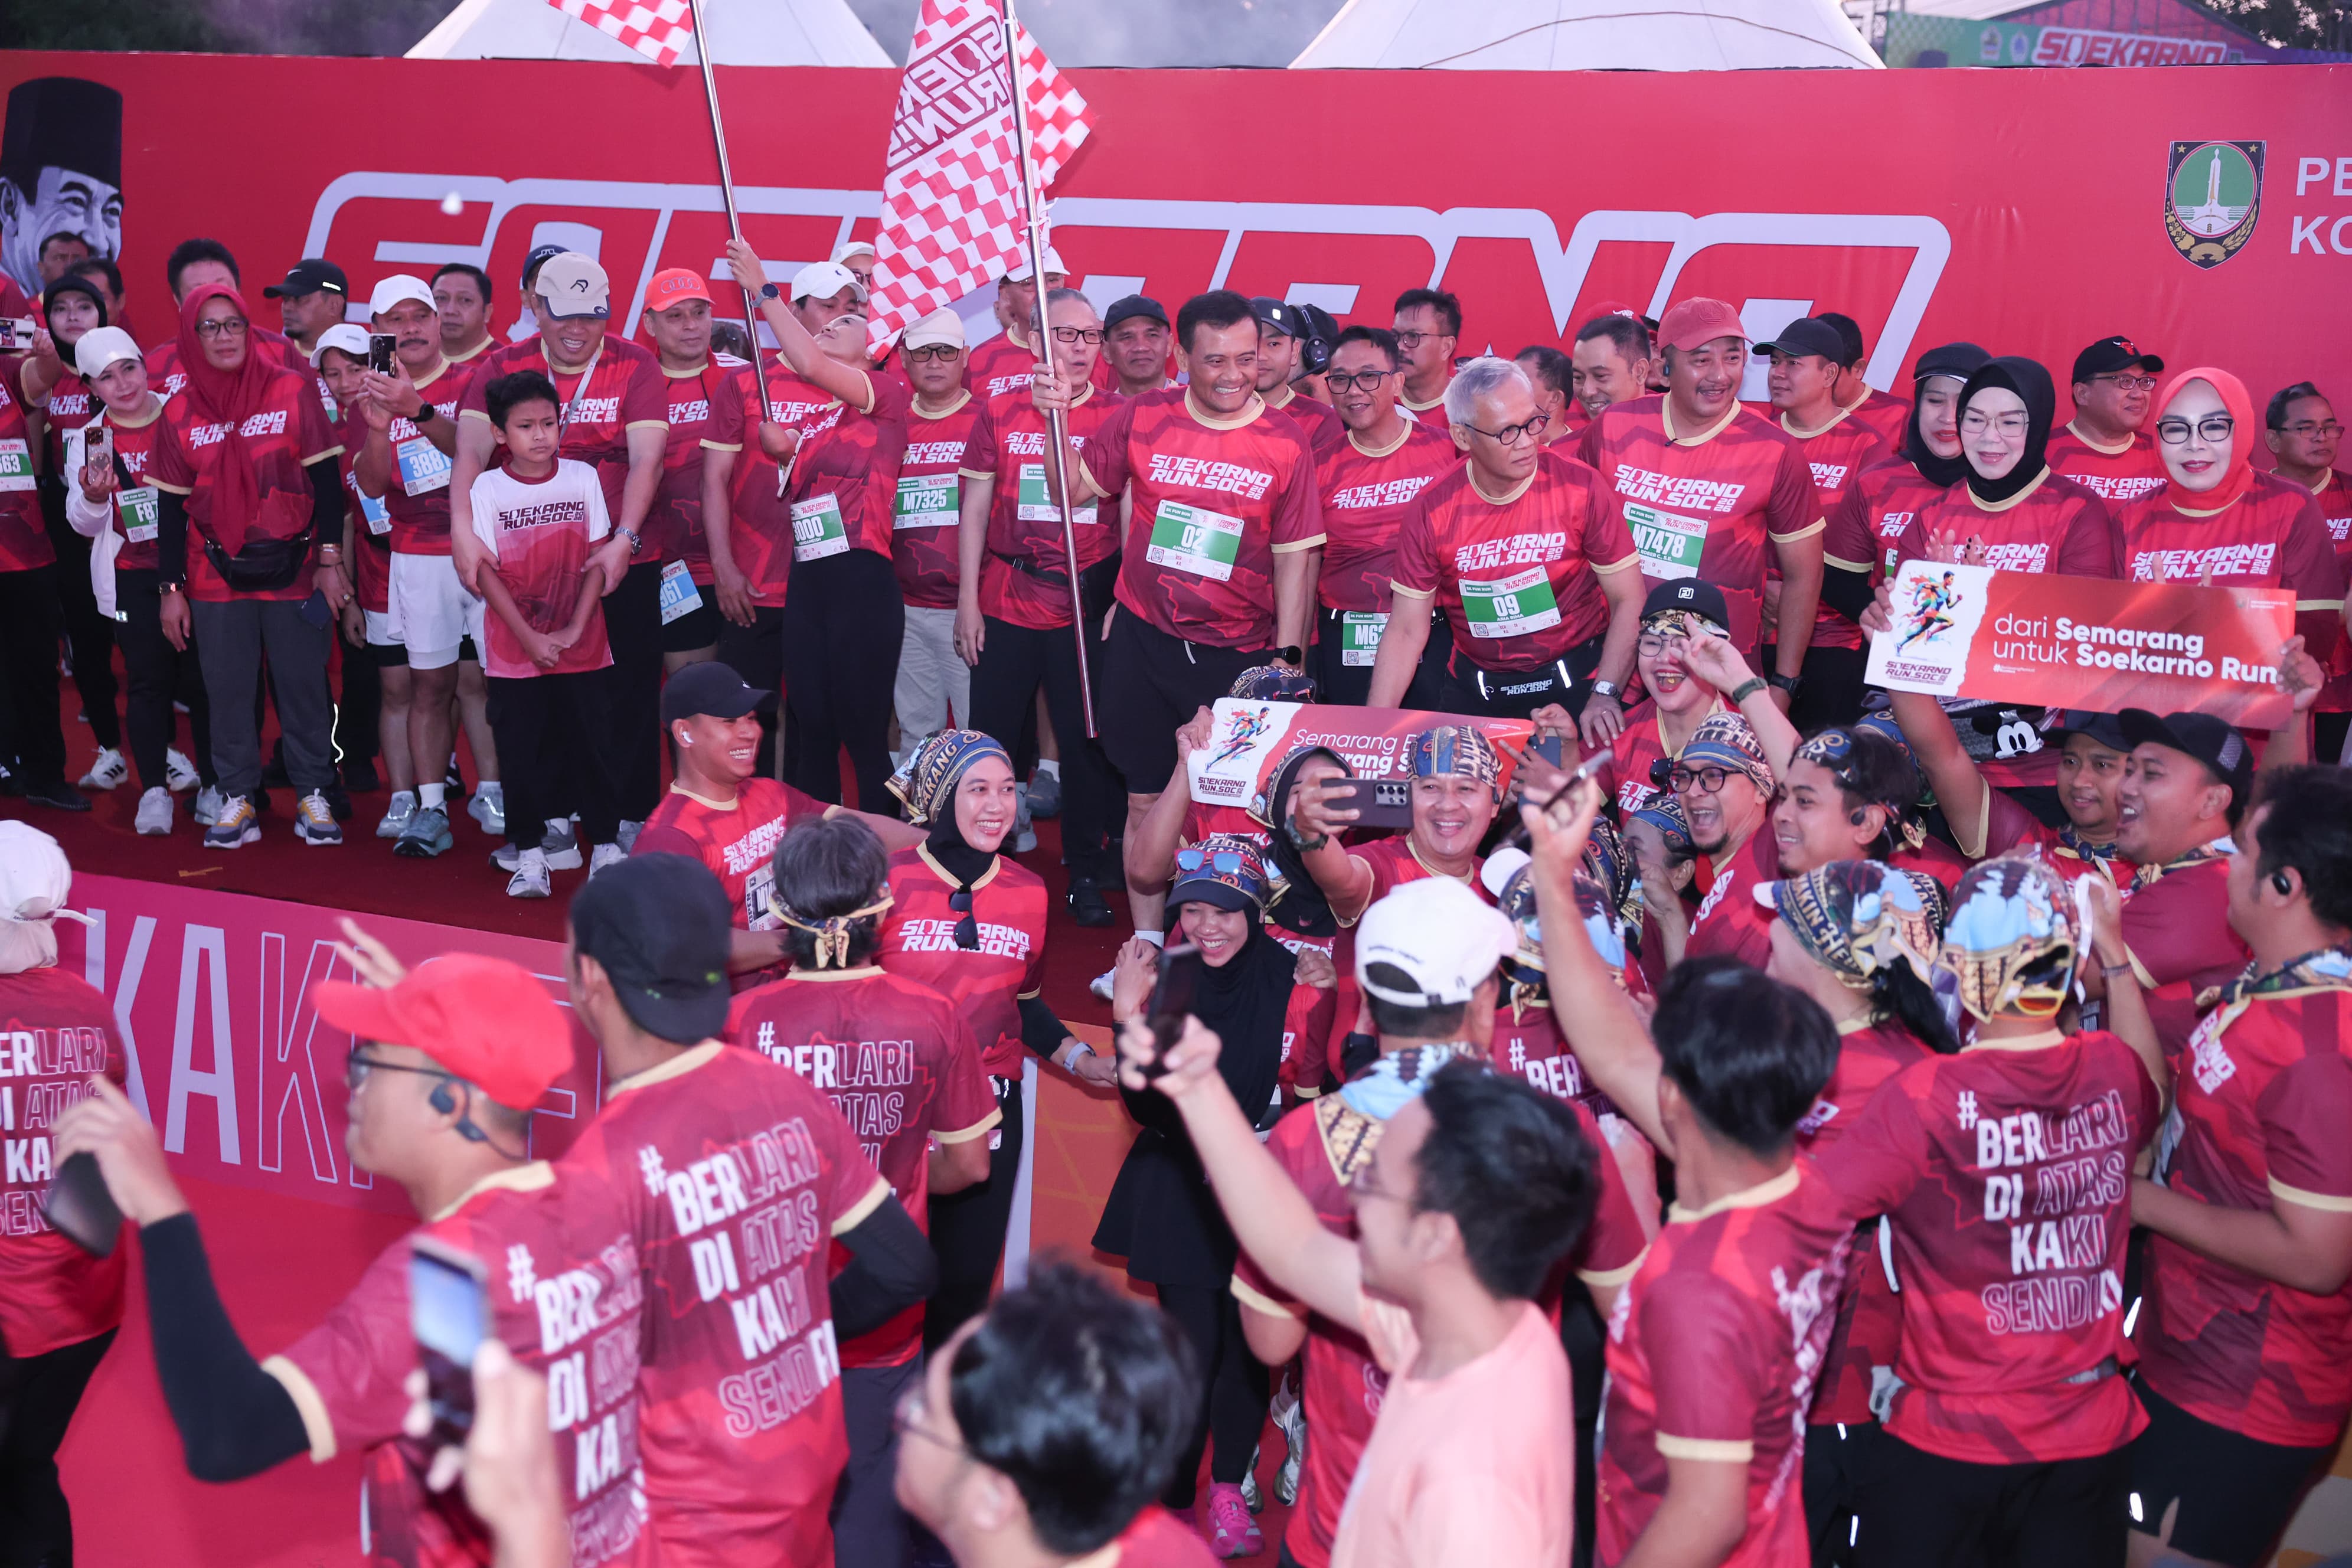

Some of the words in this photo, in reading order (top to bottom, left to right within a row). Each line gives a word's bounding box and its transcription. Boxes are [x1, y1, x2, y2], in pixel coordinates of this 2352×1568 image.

[1149, 453, 1273, 488] SOEKARNO
[1149, 469, 1249, 495] RUN.SOC
[1614, 463, 1746, 499] SOEKARNO
[903, 489, 946, 511] M7325
[1614, 479, 1717, 512] RUN.SOC
[498, 501, 584, 522] SOEKARNO
[504, 513, 574, 531] RUN.SOC
[1172, 545, 1191, 554] AHMAD
[1181, 524, 1206, 551] 02
[1455, 532, 1566, 563] SOEKARNO
[1632, 522, 1687, 558] M7478
[1458, 547, 1546, 573] RUN.SOC
[1492, 594, 1521, 618] 09
[1995, 613, 2047, 638] dari
[2054, 618, 2204, 658] Semarang
[1885, 660, 1952, 675] SOEKARNO
[1993, 641, 2069, 665] untuk
[2075, 643, 2214, 678] Soekarno
[2220, 656, 2278, 684] Run
[1500, 679, 1553, 692] SOEKARNO
[1507, 684, 1549, 696] RUN.SOC
[1292, 729, 1398, 756] Semarang
[1197, 776, 1247, 788] SOEKARNO
[1199, 784, 1236, 794] RUN.SOC
[1956, 1089, 2129, 1170] #BERLARI
[1983, 1175, 2024, 1221] DI
[2033, 1152, 2126, 1216] ATAS
[689, 1231, 740, 1303] DI
[741, 1189, 821, 1282] ATAS
[2010, 1214, 2108, 1275] KAKI
